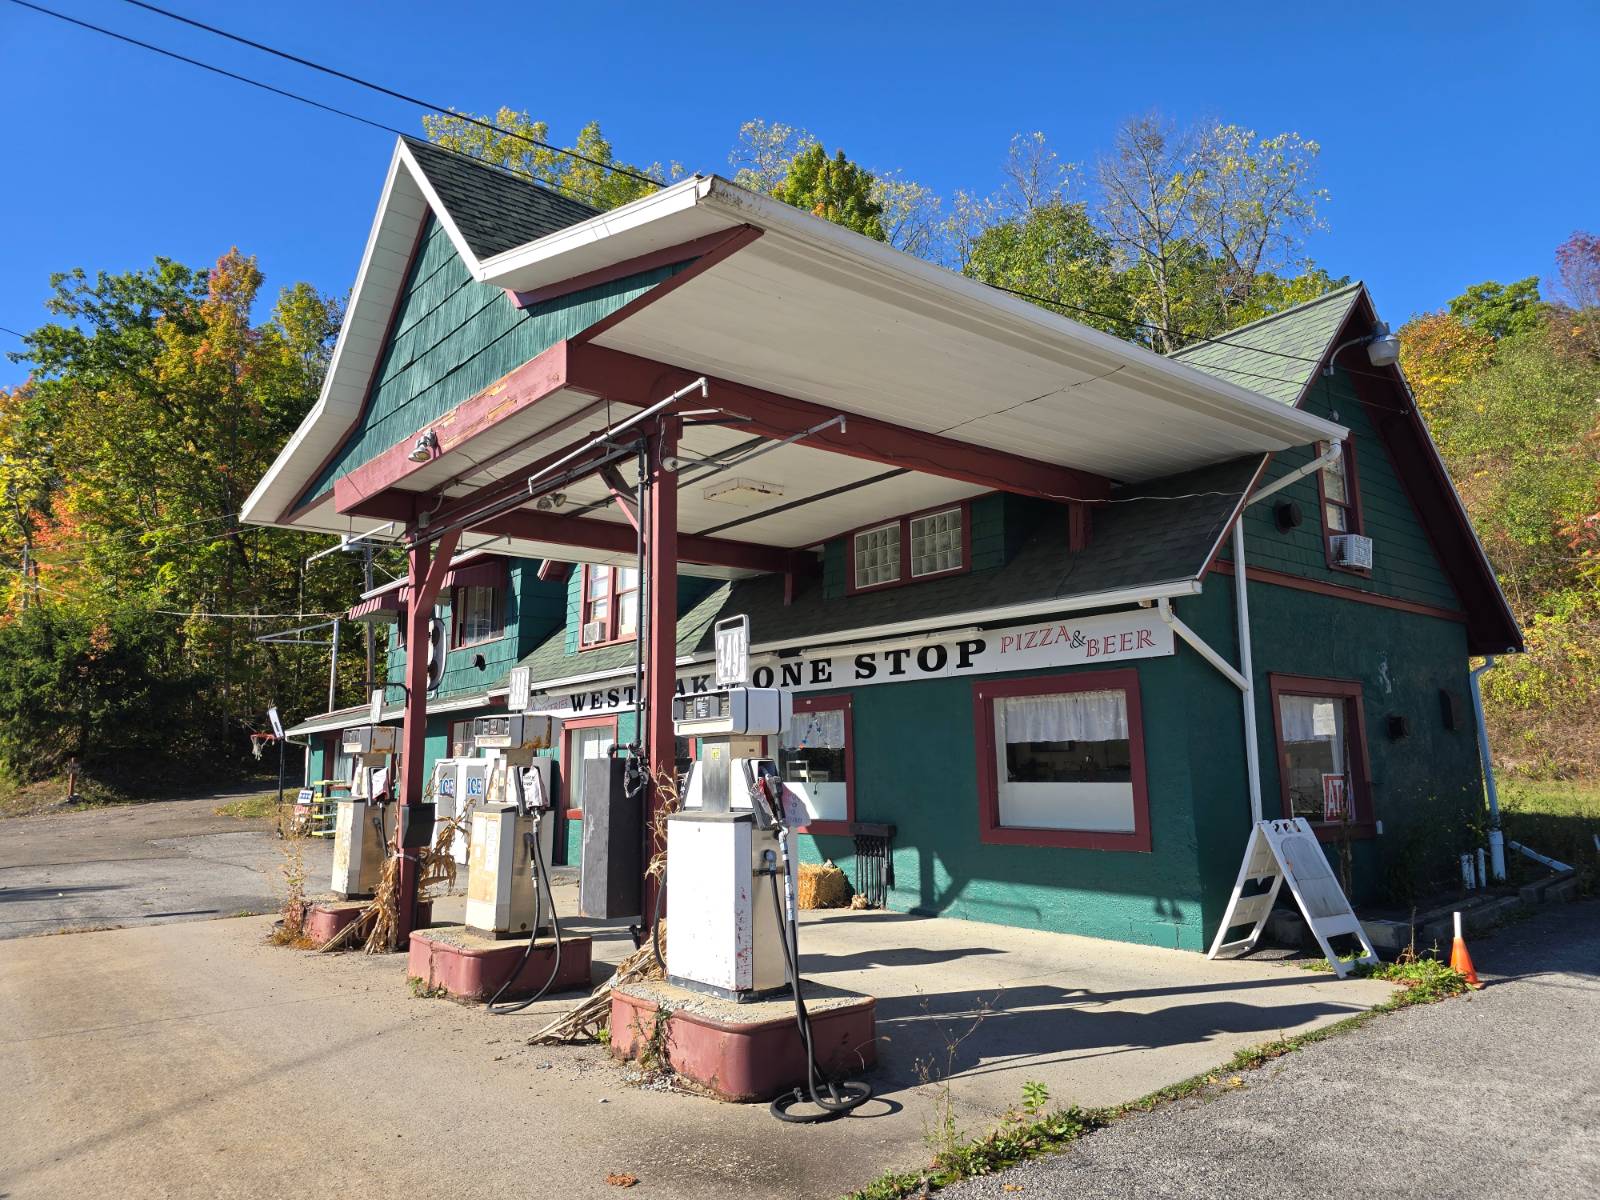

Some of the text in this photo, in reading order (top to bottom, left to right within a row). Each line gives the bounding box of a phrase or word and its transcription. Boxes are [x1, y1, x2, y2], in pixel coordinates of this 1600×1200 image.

[1000, 625, 1157, 657] PIZZA & BEER
[570, 686, 638, 712] WEST
[753, 659, 832, 689] ONE
[854, 638, 986, 680] STOP
[440, 778, 453, 794] ICE
[467, 778, 482, 795] ICE
